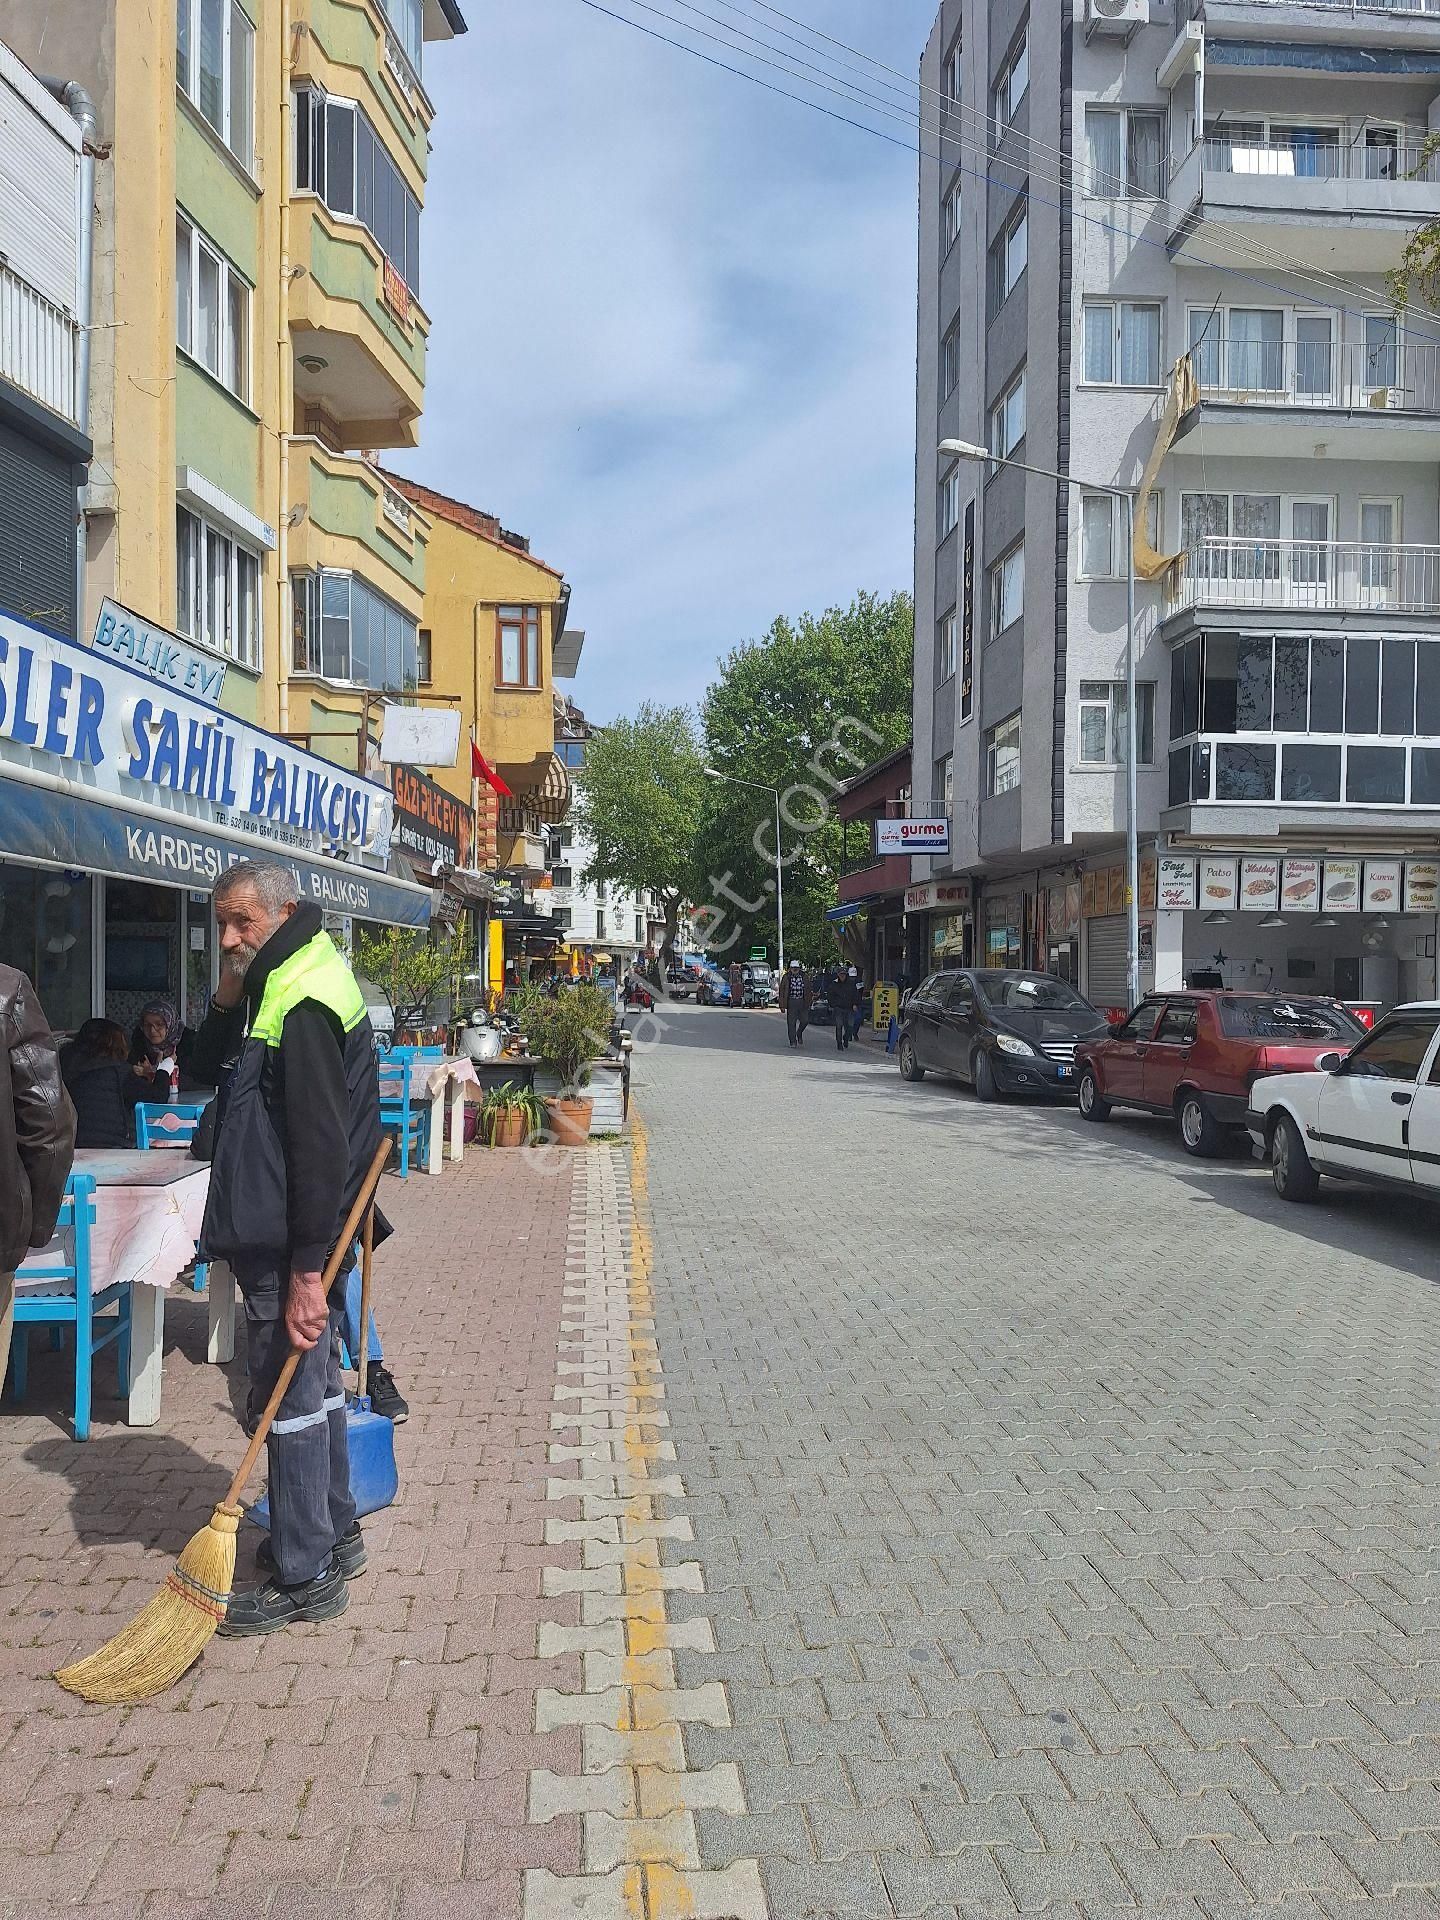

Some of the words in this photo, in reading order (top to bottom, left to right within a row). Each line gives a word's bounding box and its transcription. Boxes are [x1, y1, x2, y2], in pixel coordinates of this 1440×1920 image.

[96, 612, 180, 679] BALIK
[184, 658, 224, 700] EVİ
[128, 698, 236, 806] SAHİL
[249, 747, 369, 849] BALIKÇISI
[395, 768, 420, 816] GAZİ
[443, 799, 456, 838] EVİ
[901, 824, 945, 838] gurme
[126, 825, 250, 882] KARDEŞLE
[311, 872, 369, 909] BALIKÇISI
[1161, 861, 1186, 871] Fast
[1206, 867, 1232, 877] Patso
[1245, 864, 1276, 876] Hotdog
[1161, 889, 1184, 899] Self
